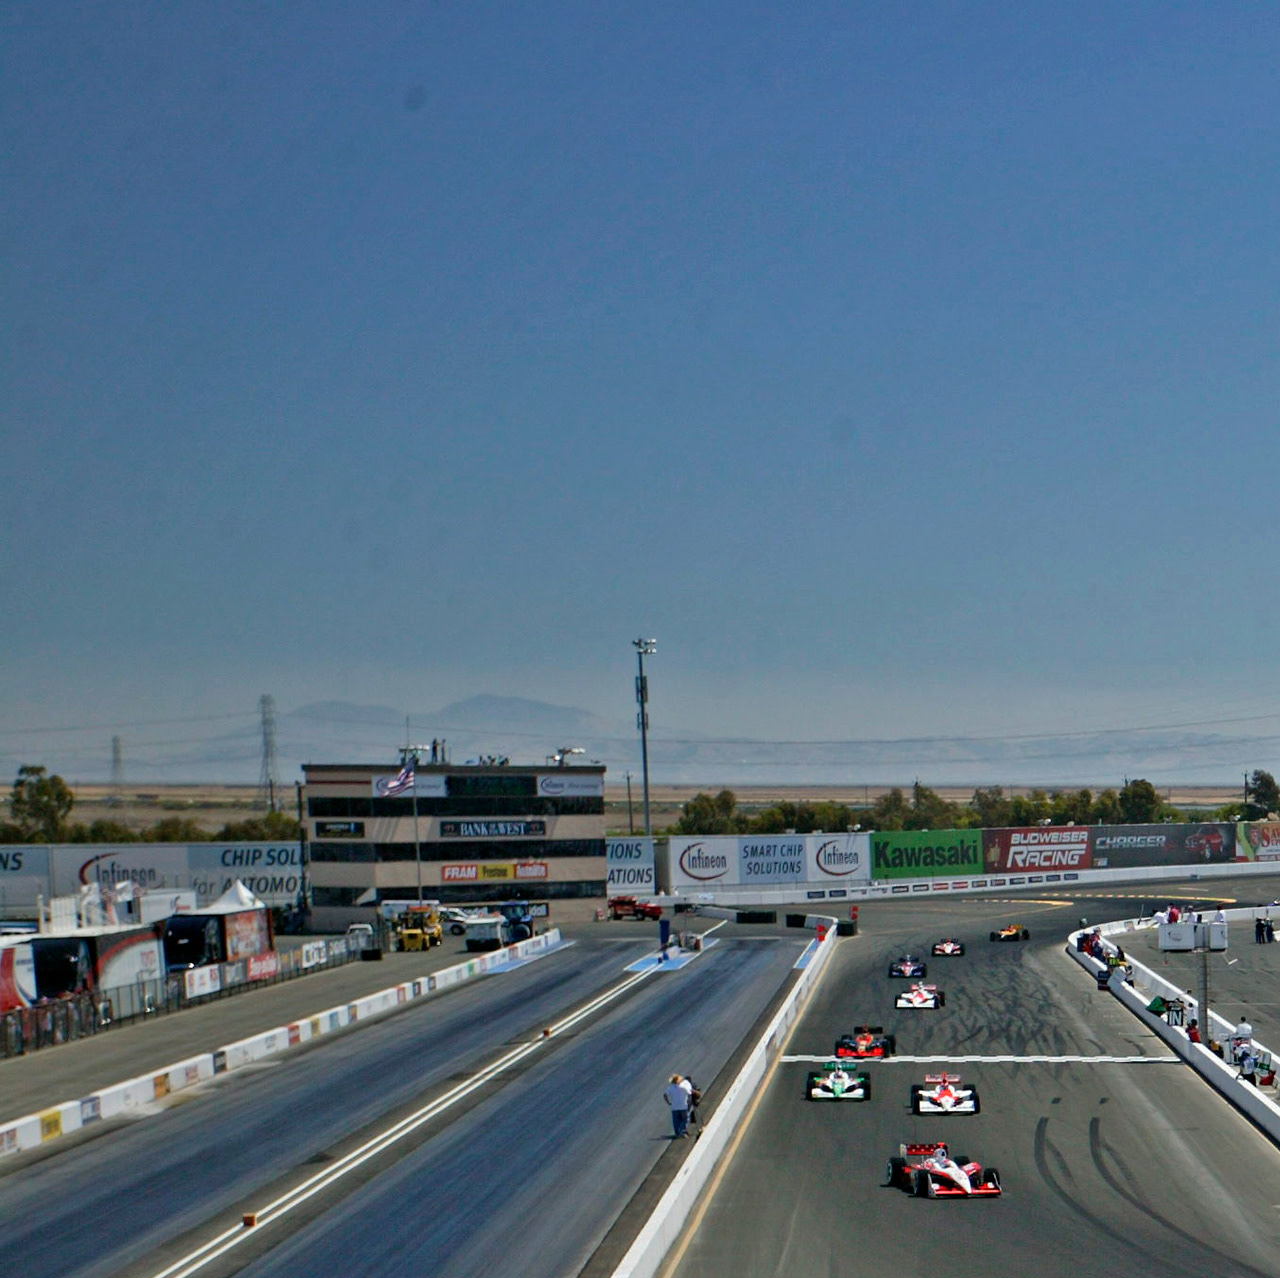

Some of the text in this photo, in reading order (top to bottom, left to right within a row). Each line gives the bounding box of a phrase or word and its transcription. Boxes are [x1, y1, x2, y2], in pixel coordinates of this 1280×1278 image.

[460, 823, 488, 835] BANK
[498, 823, 526, 835] WEST
[1011, 831, 1089, 844] BUDWEISER
[221, 849, 262, 867] CHIP
[687, 845, 727, 870] Infineon
[742, 843, 804, 859] SMART CHIP
[823, 842, 859, 866] Infineon
[874, 839, 979, 869] Kawasaki
[1006, 844, 1087, 868] RACING
[444, 867, 477, 879] FRAM
[746, 861, 802, 876] SOLUTIONS
[1169, 1010, 1182, 1025] IN
